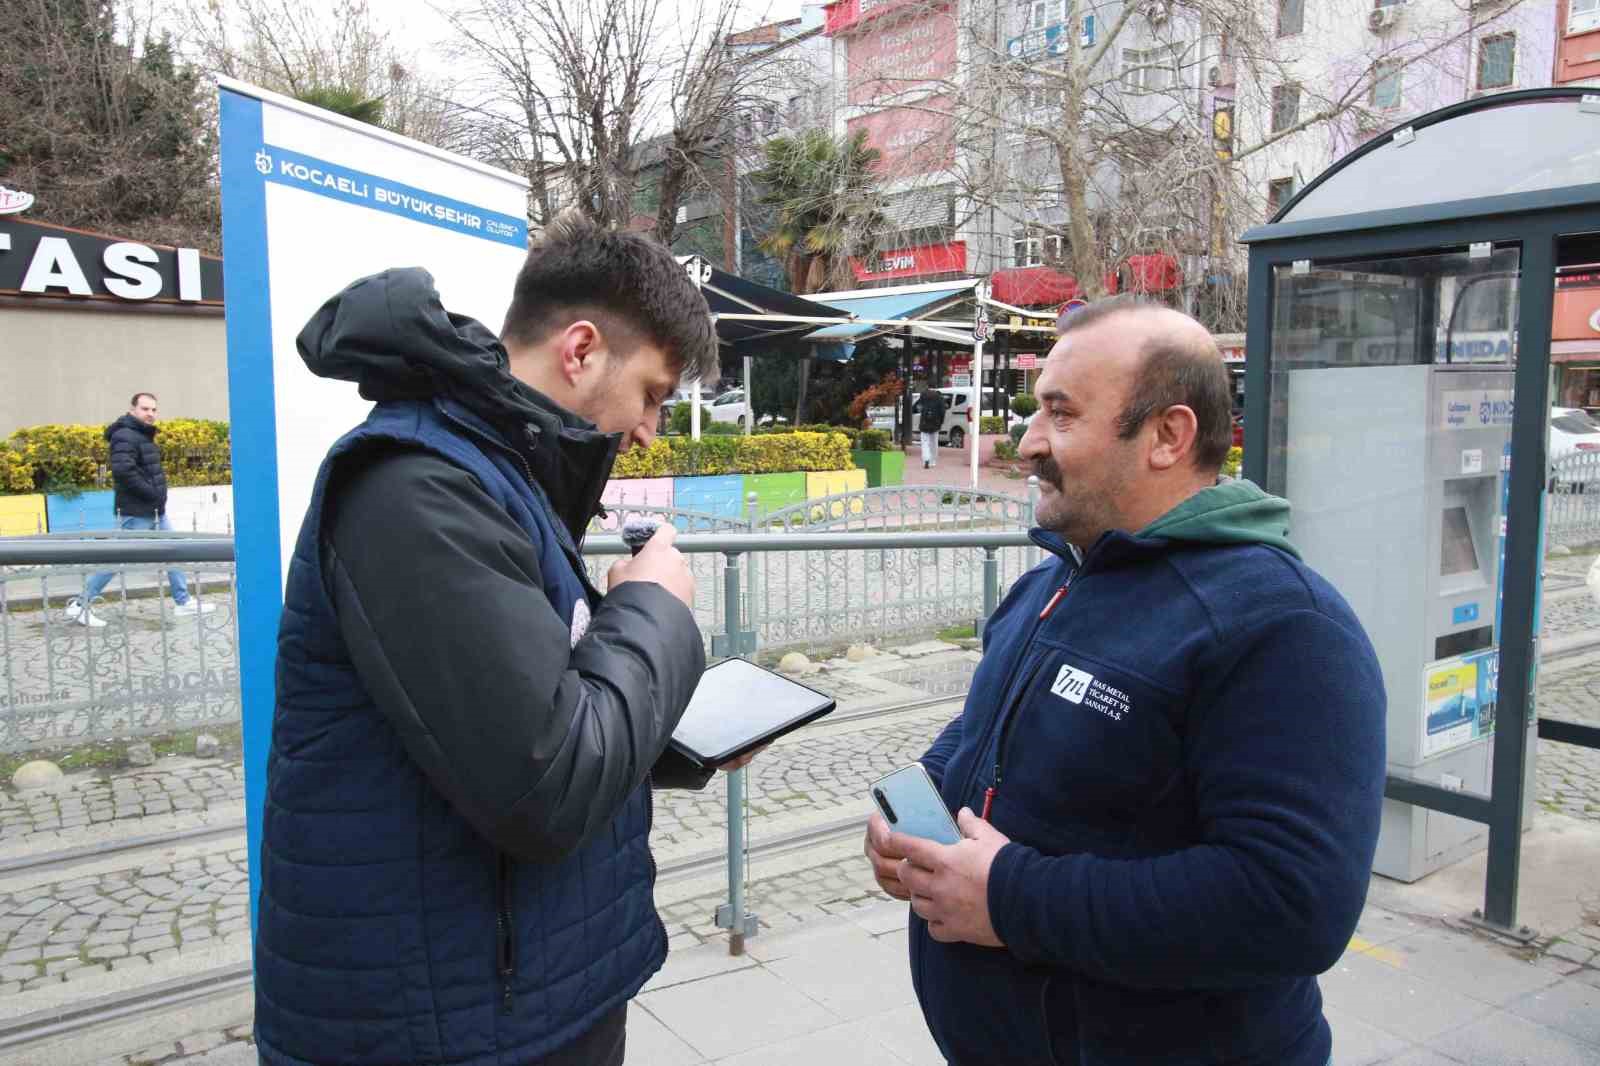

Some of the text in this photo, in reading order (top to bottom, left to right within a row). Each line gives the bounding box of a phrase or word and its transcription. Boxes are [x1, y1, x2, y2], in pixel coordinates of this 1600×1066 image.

[280, 160, 482, 230] KOCAELİ BÜYÜKŞEHİR
[1105, 686, 1130, 703] METAL
[1119, 702, 1131, 713] VE
